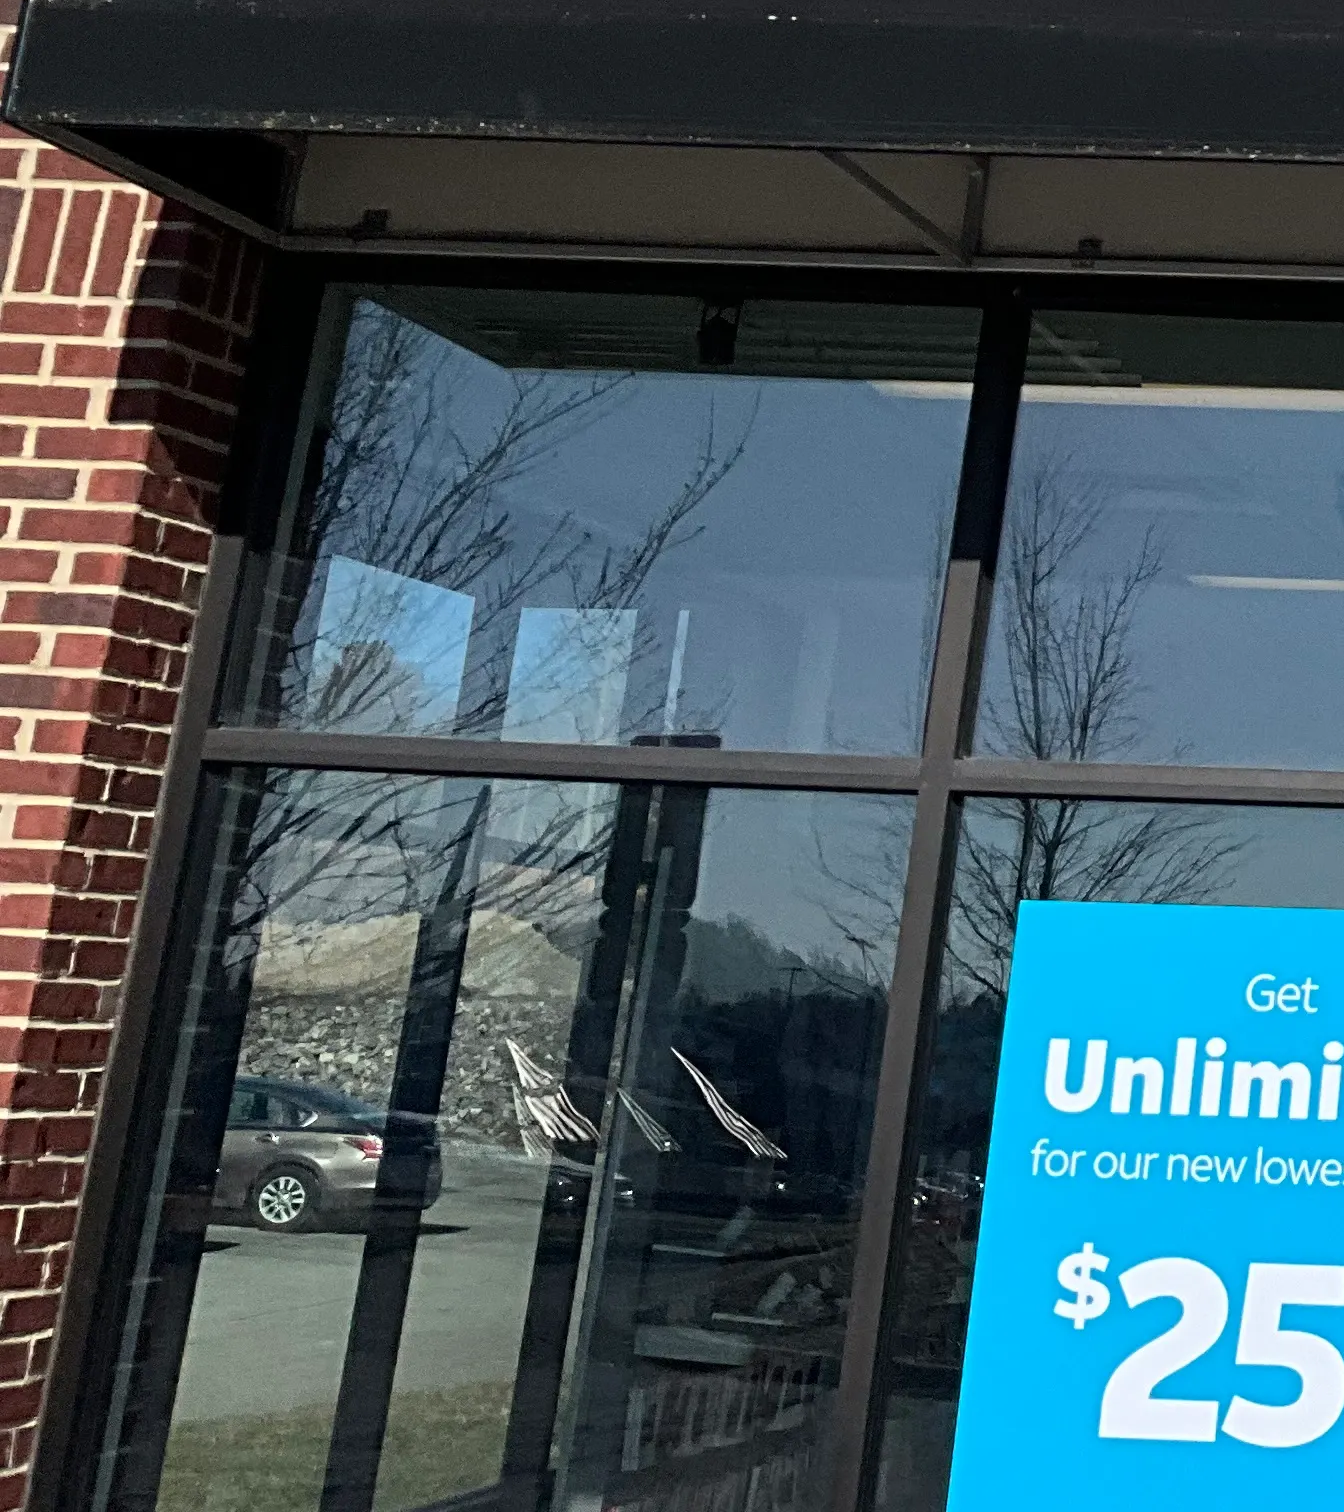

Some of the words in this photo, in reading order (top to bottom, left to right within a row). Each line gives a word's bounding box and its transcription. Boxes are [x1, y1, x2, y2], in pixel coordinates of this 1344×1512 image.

[1245, 973, 1319, 1014] Get
[1030, 1139, 1087, 1178] for
[1093, 1152, 1160, 1181] our
[1166, 1153, 1248, 1184] new
